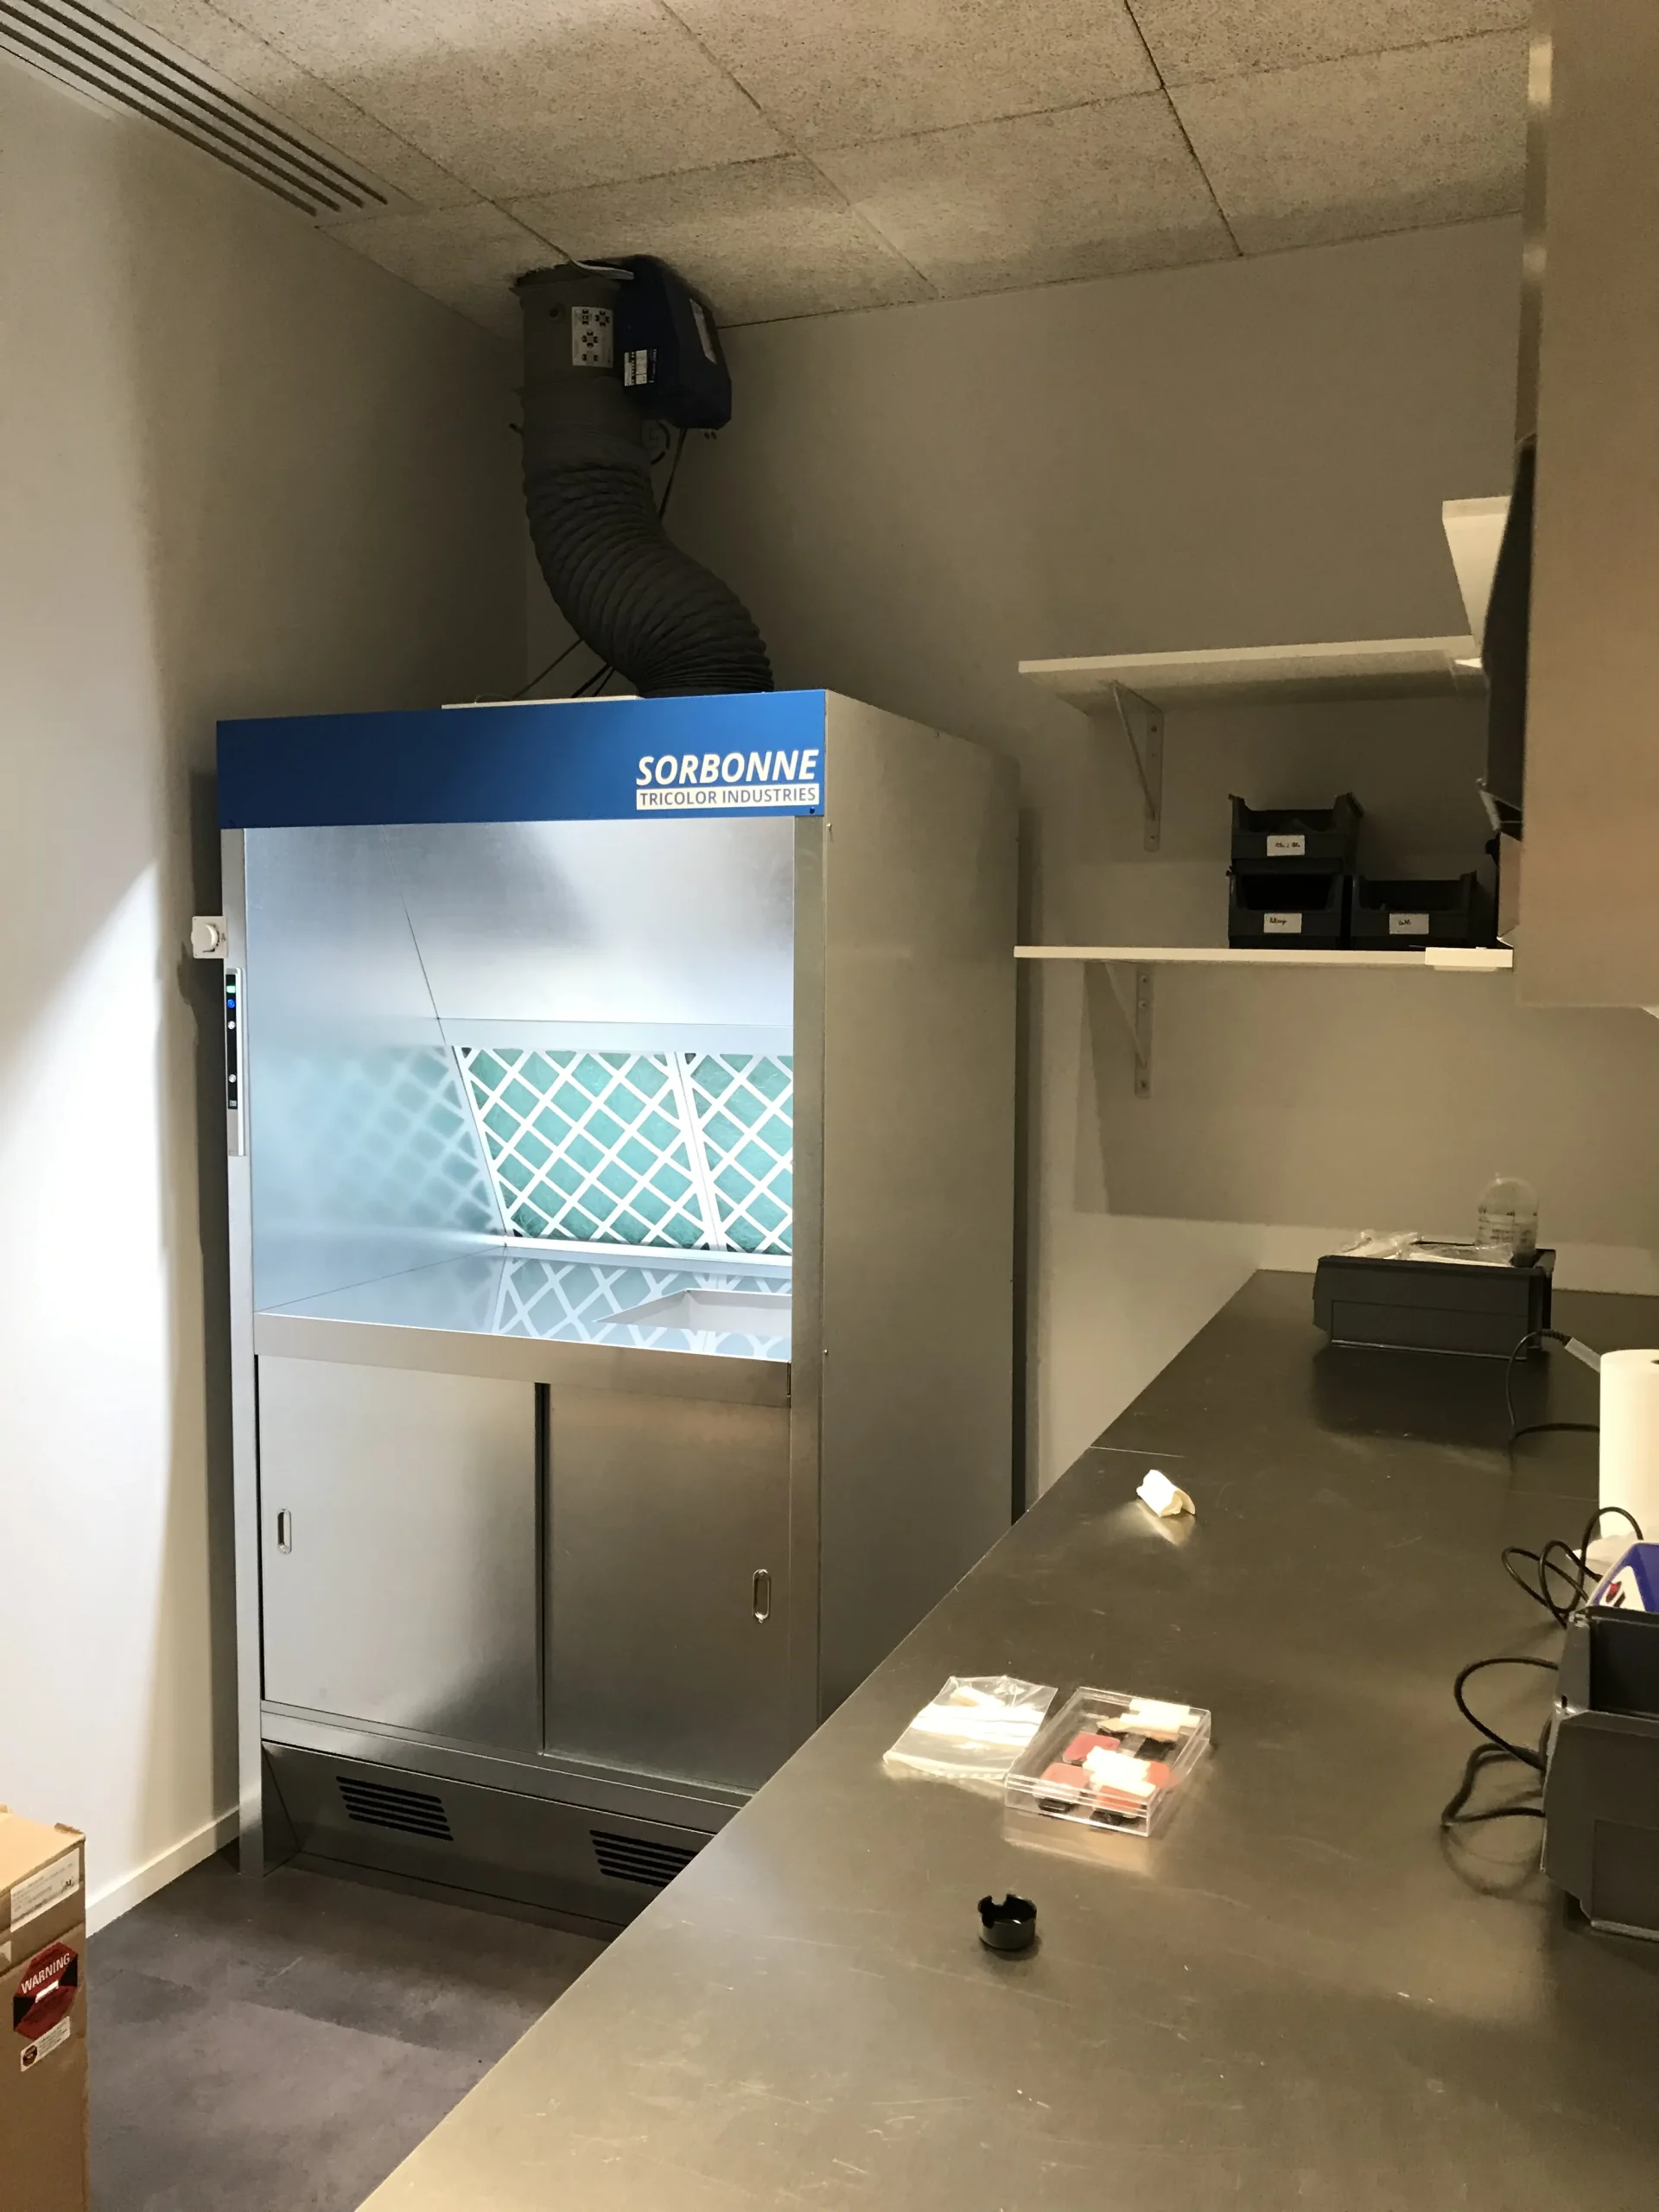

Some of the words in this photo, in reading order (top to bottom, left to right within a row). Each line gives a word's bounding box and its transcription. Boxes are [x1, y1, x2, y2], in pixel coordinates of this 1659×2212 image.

[636, 749, 819, 786] SORBONNE
[640, 791, 717, 806] TRICOLOR
[722, 787, 816, 804] INDUSTRIES
[21, 1952, 71, 1995] WARNING
